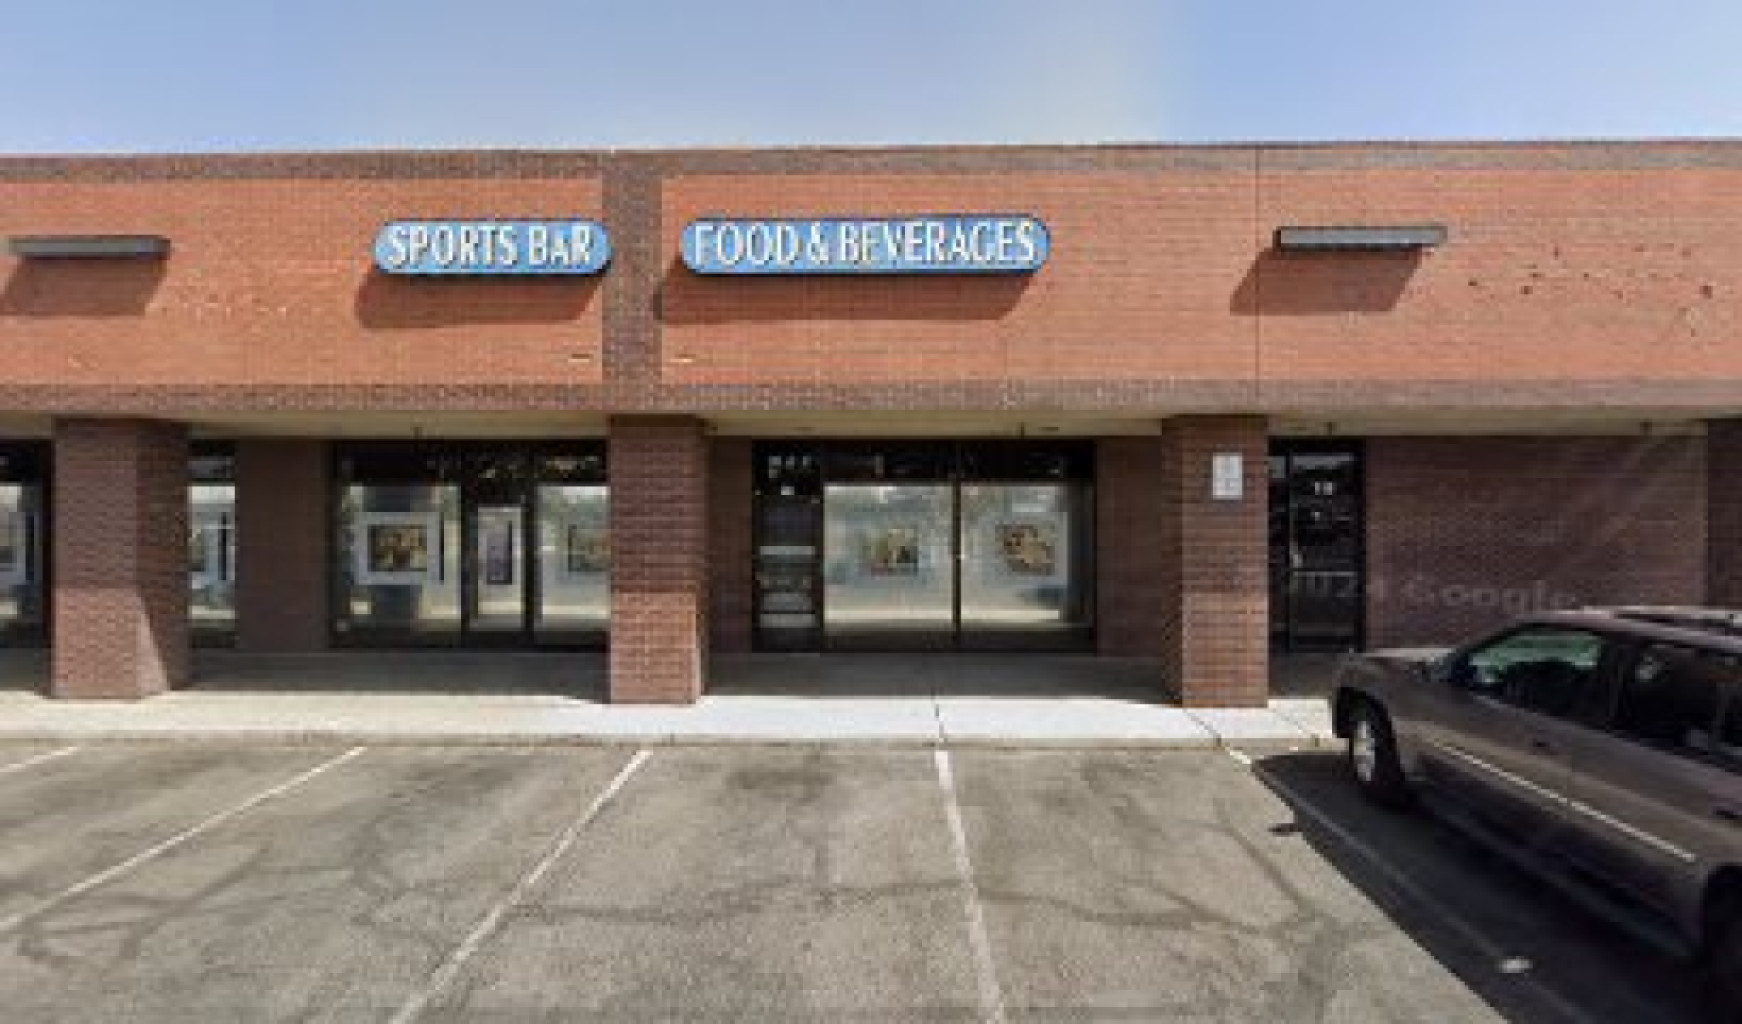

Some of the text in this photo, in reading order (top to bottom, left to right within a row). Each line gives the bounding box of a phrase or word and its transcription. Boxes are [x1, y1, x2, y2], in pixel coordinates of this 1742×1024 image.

[387, 224, 594, 266] SPORTS BAR
[694, 219, 1037, 265] FOOD & BEVERAGES
